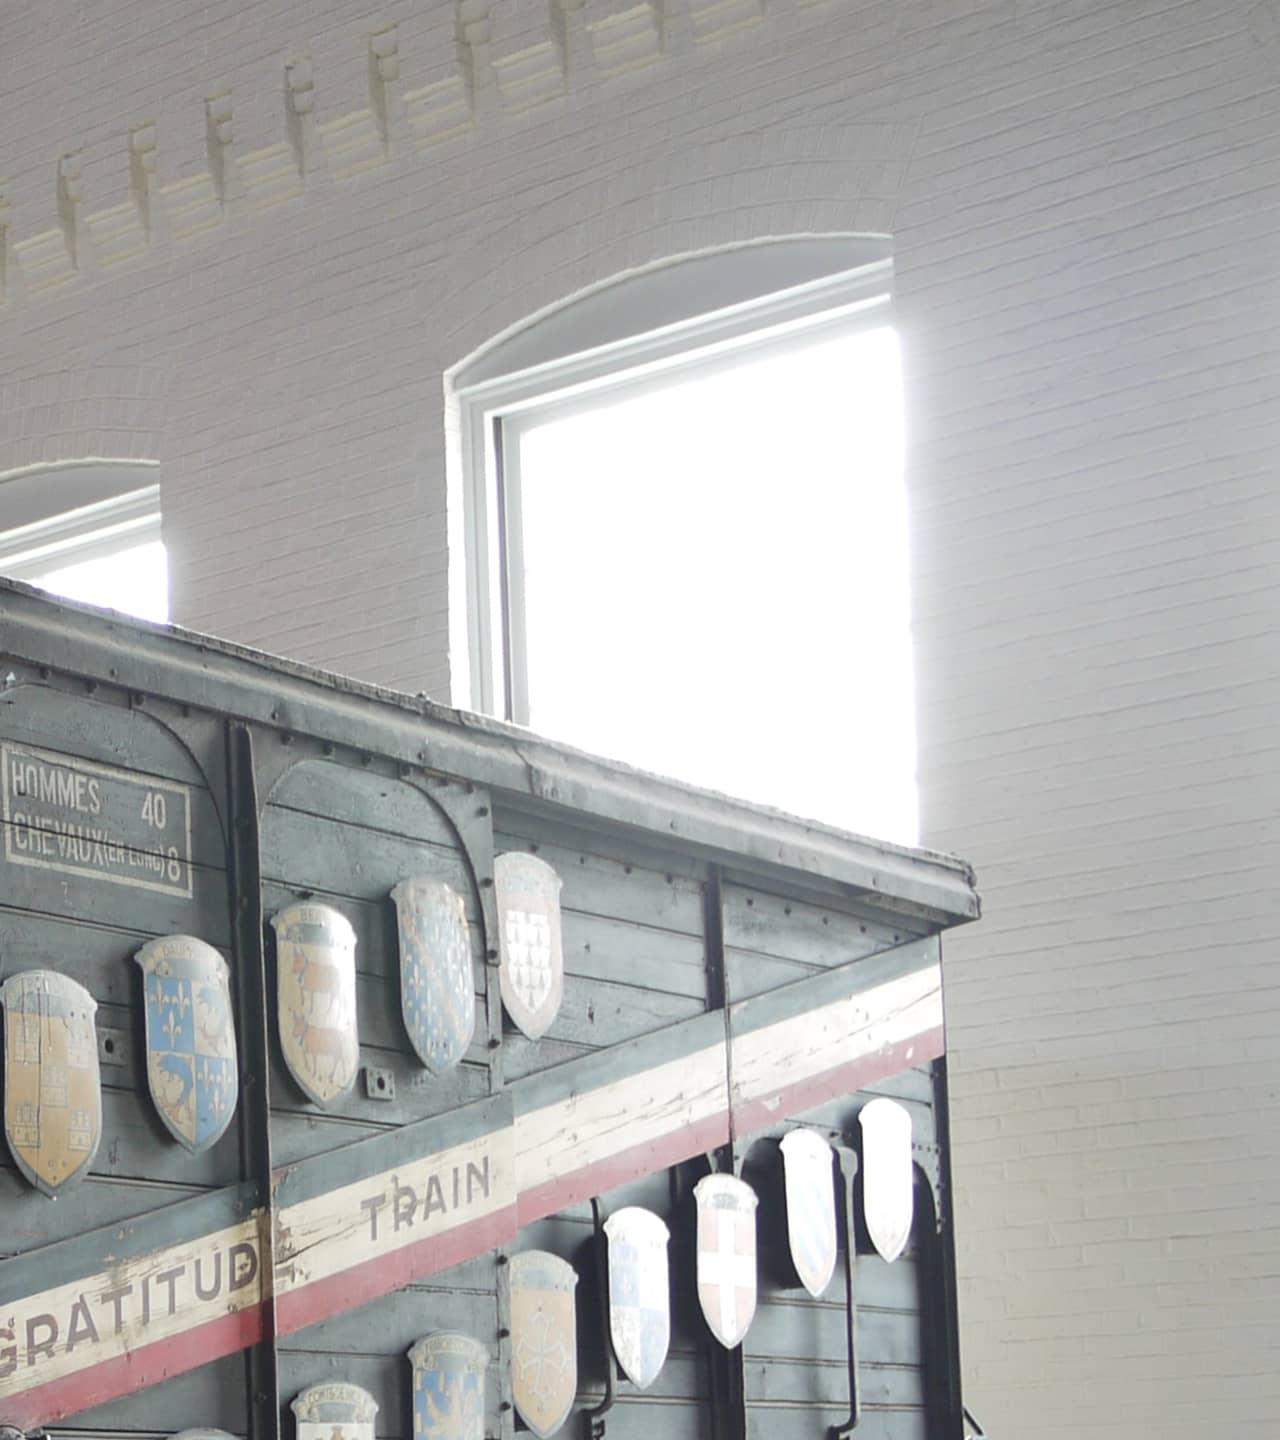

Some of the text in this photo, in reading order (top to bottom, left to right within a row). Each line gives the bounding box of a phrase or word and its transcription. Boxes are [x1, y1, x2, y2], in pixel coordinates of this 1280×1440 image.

[11, 759, 168, 830] HOMMES 40
[13, 811, 104, 866] CHEVAUX
[167, 846, 181, 882] 8
[359, 1156, 490, 1241] TRAIN
